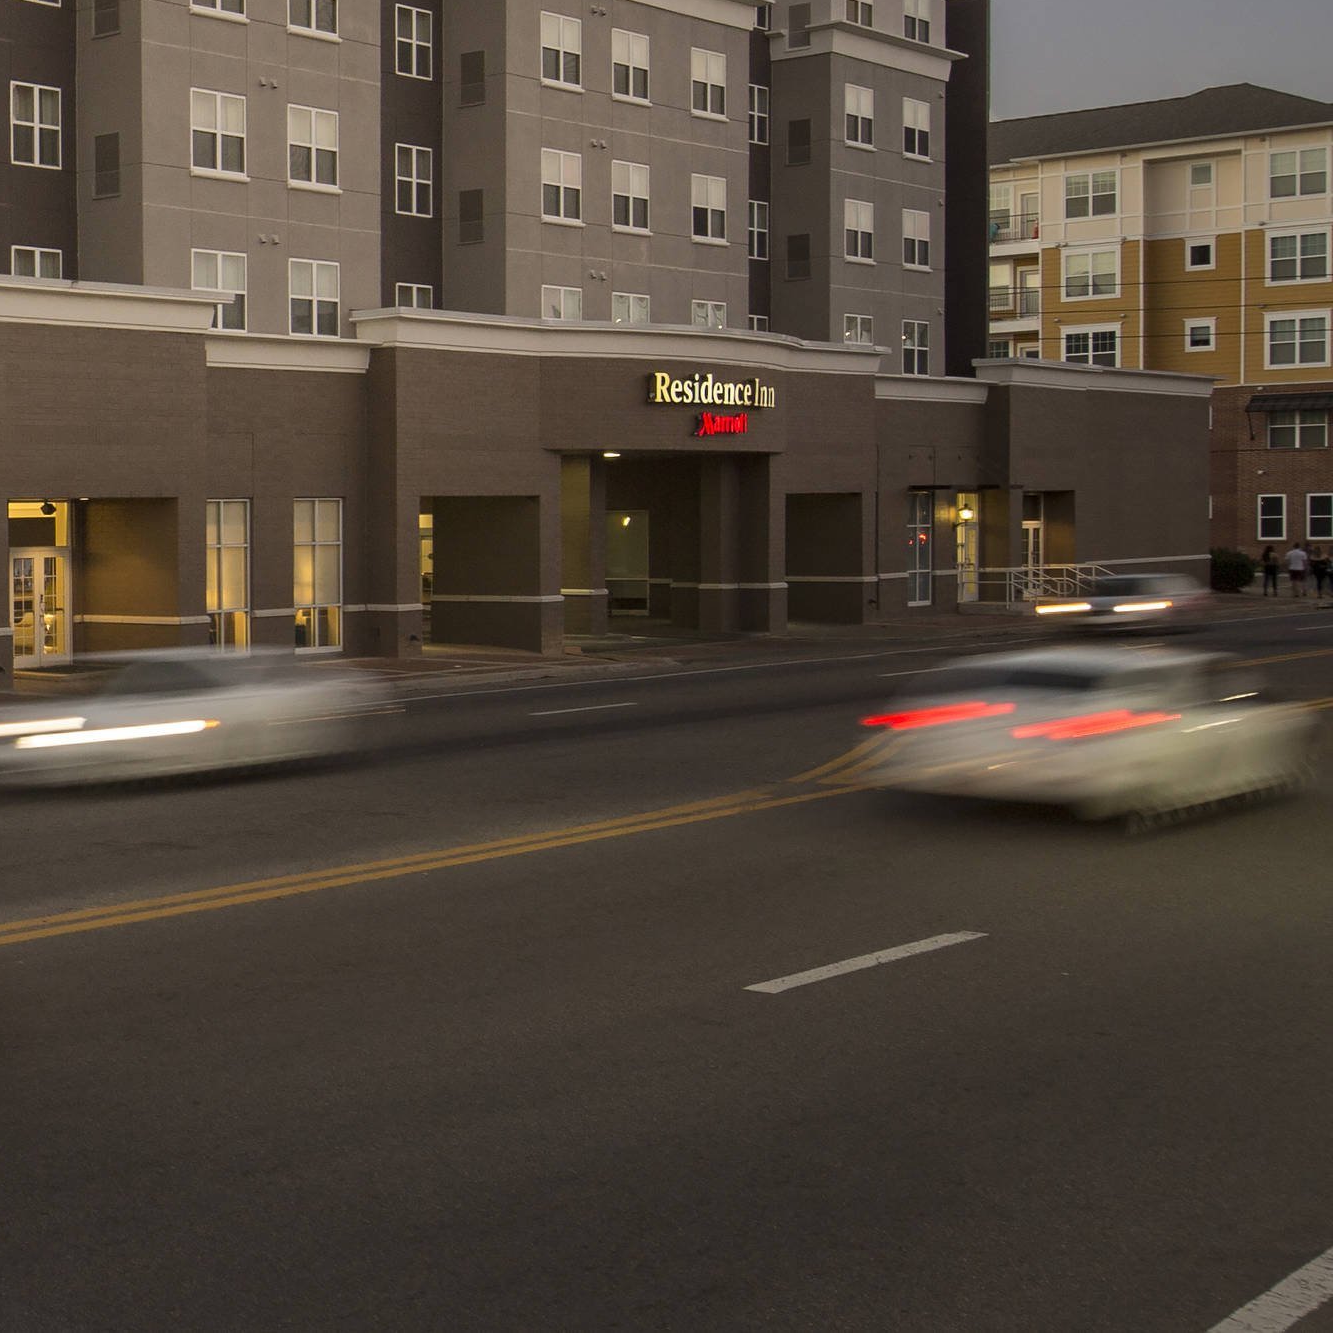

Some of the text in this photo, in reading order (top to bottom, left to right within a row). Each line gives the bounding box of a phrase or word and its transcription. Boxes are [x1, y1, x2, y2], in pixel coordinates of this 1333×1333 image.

[654, 372, 776, 408] Residence Inn
[698, 412, 749, 437] Marriott
